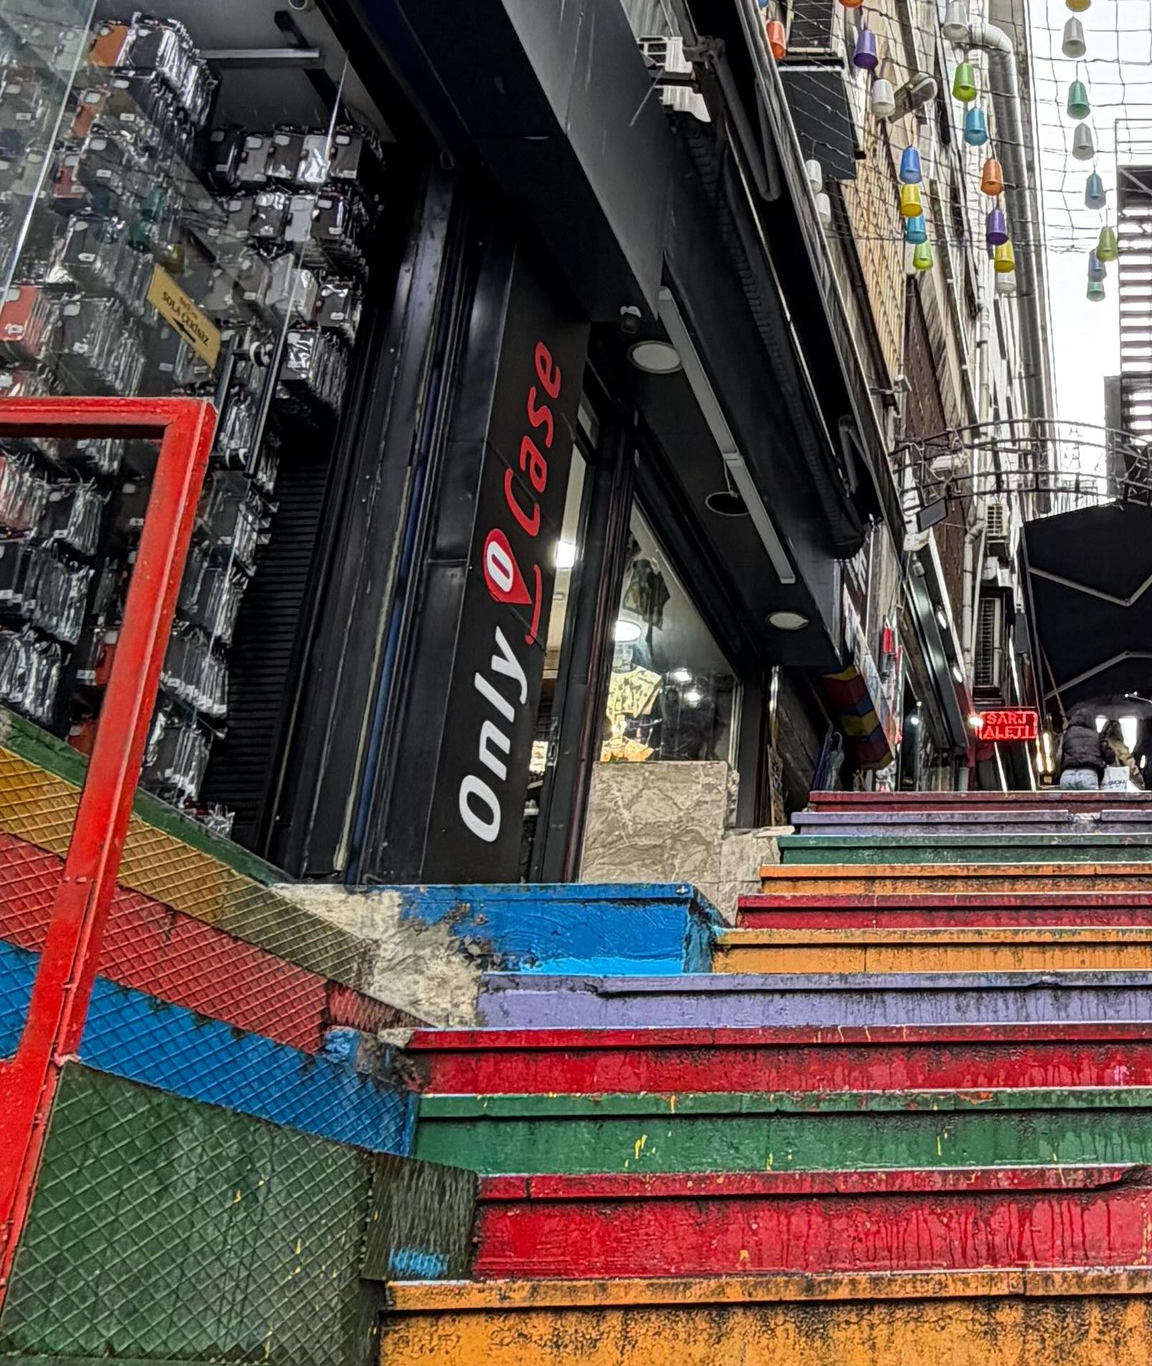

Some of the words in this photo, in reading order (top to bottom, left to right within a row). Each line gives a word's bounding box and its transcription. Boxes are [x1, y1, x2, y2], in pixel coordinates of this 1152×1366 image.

[161, 291, 182, 317] SOLA
[459, 625, 528, 843] Only
[504, 340, 563, 537] Case
